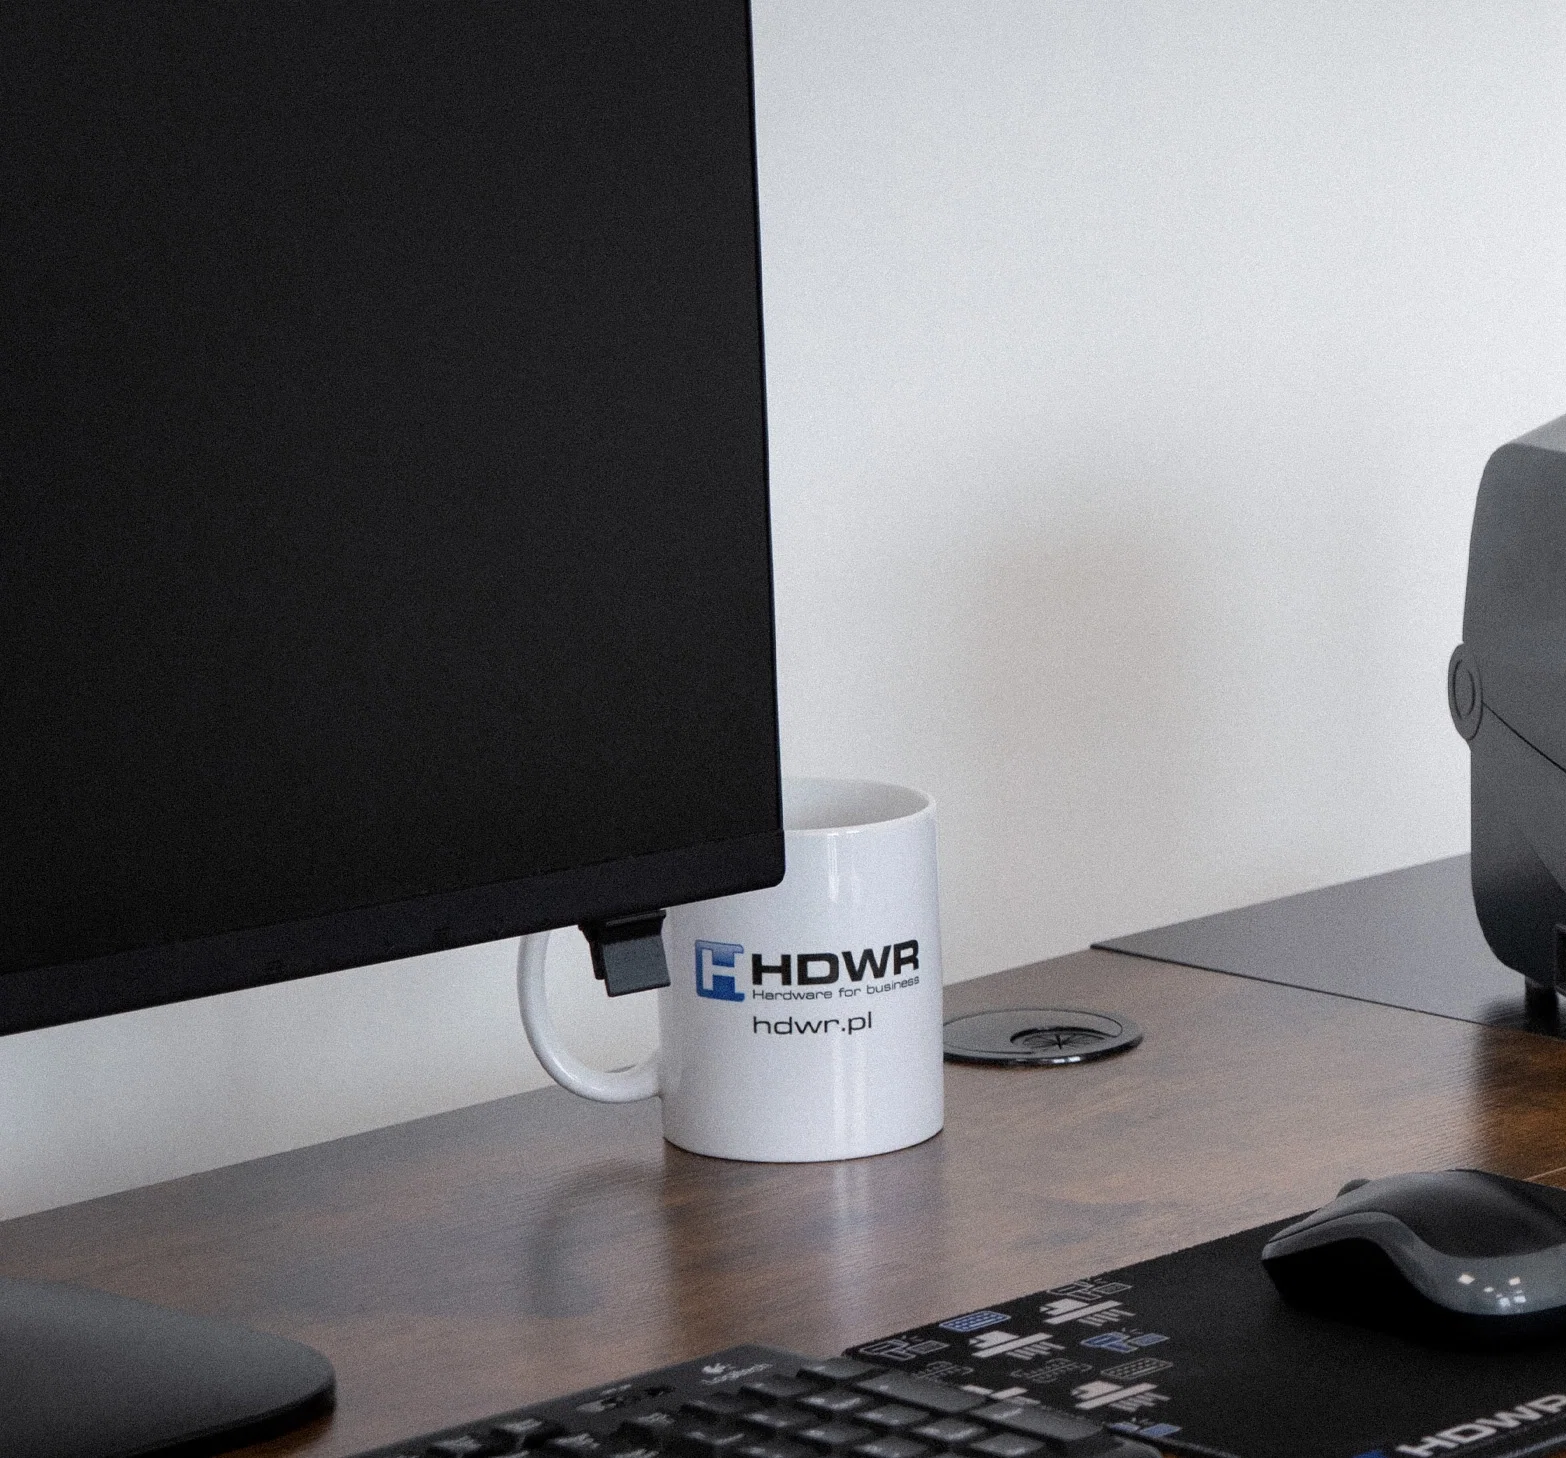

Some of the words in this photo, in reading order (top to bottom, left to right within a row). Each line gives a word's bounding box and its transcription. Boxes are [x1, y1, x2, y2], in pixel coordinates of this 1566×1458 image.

[752, 939, 919, 986] HDWR
[752, 989, 832, 1000] Hardware
[839, 986, 861, 998] for
[866, 976, 920, 995] business
[753, 1011, 872, 1035] hdwr.pl
